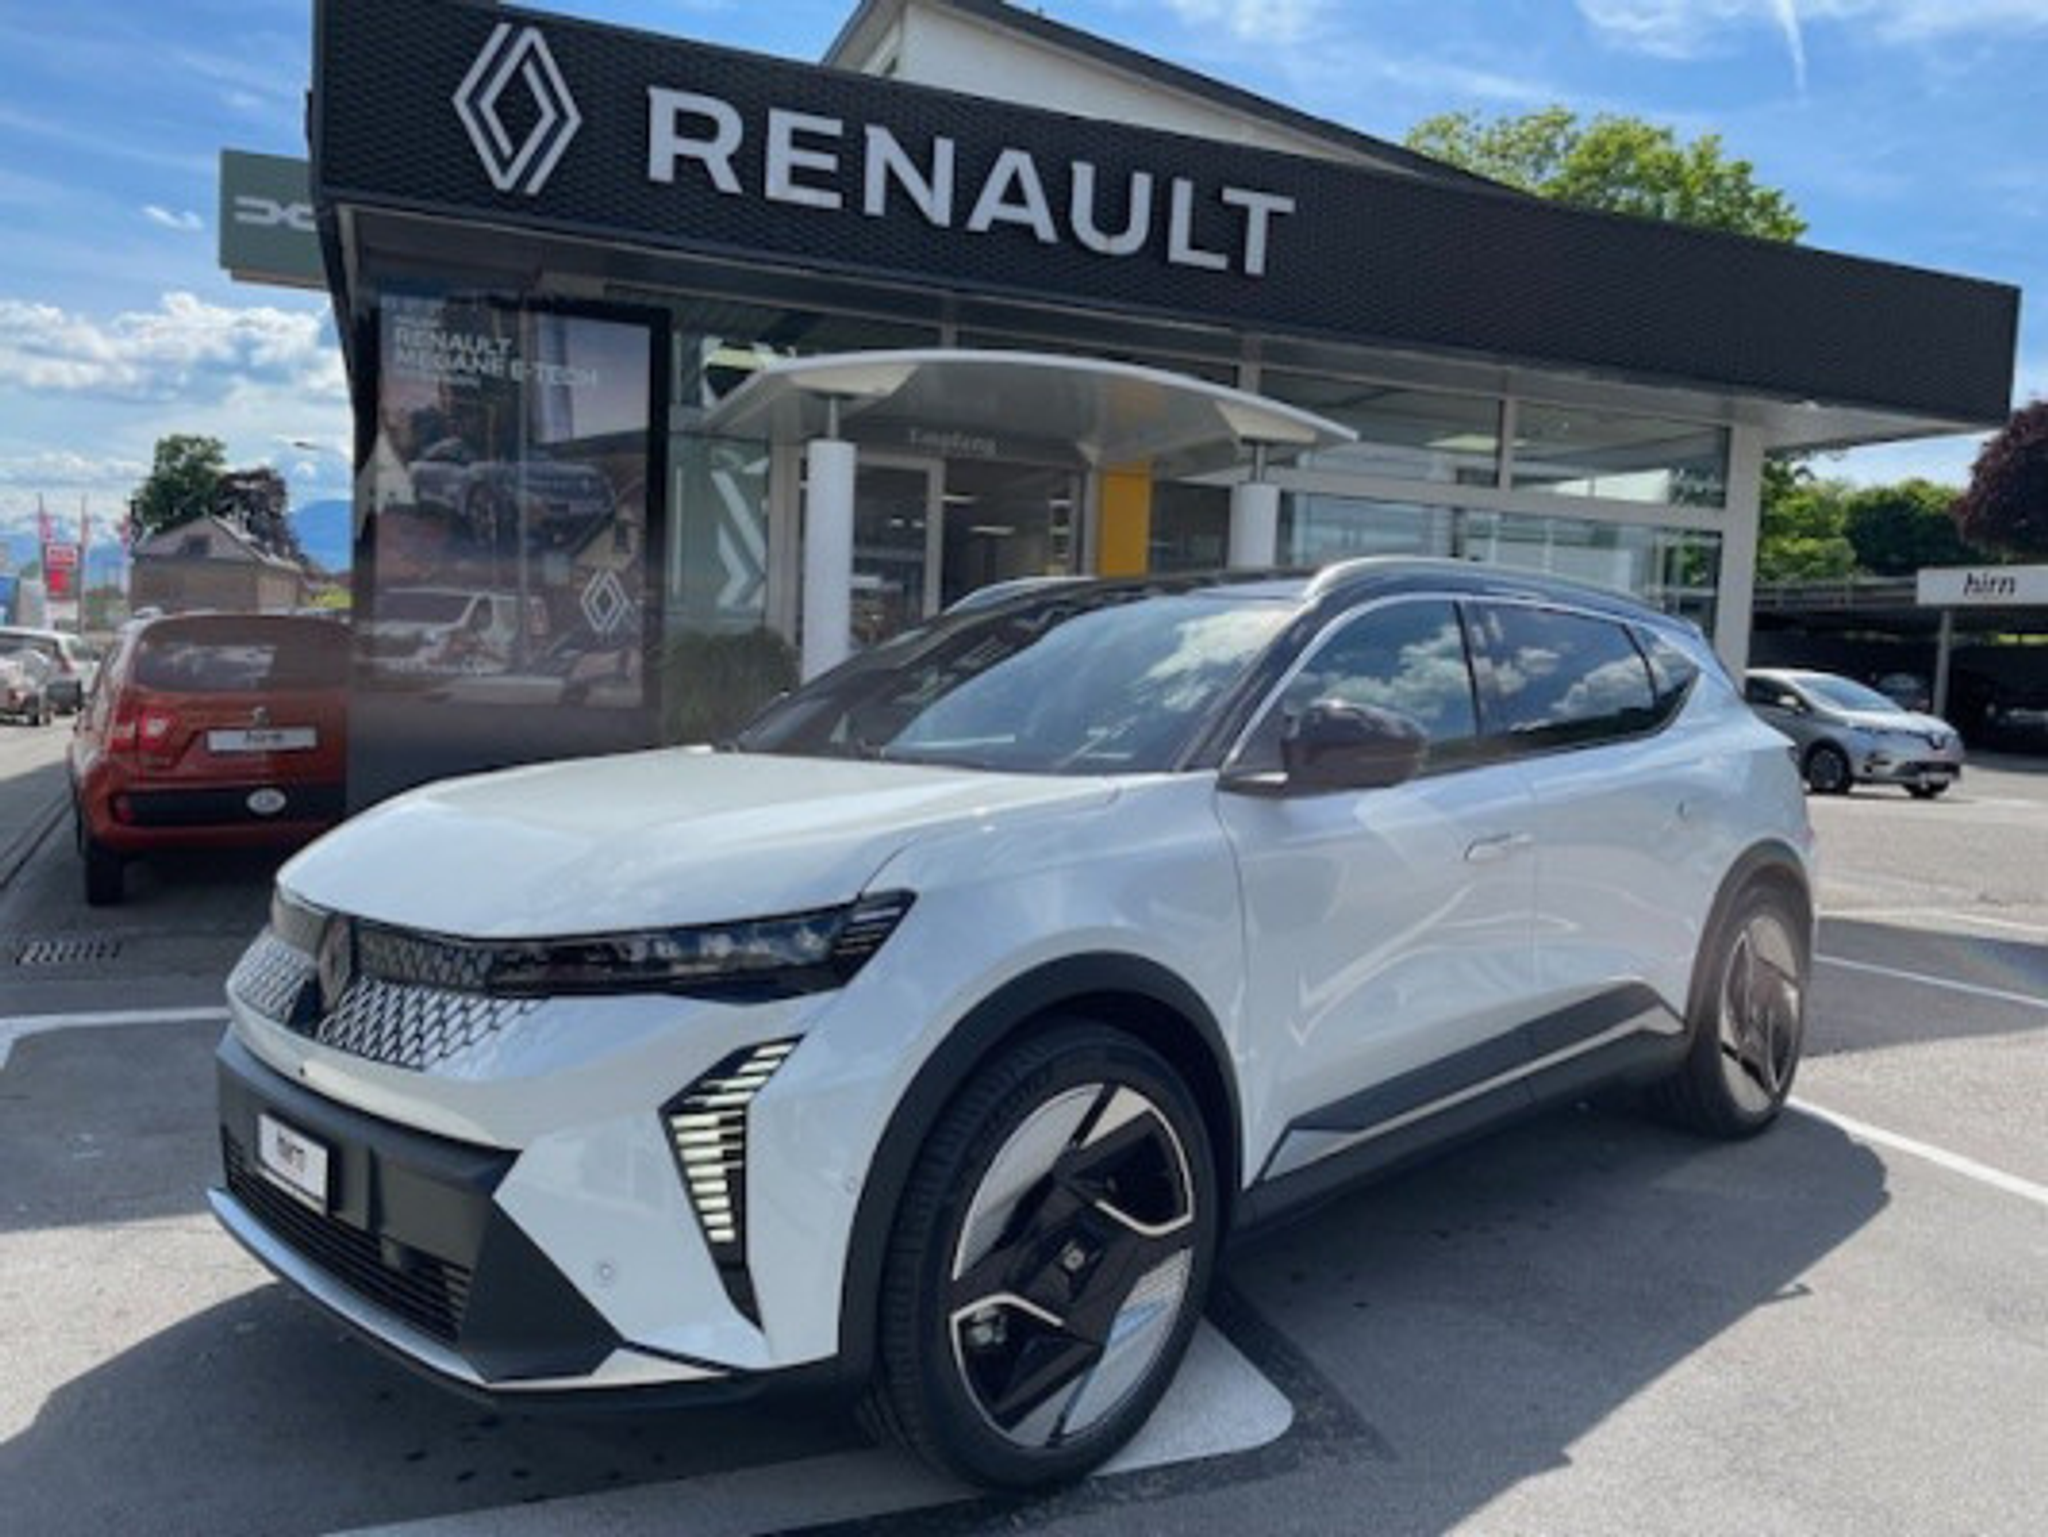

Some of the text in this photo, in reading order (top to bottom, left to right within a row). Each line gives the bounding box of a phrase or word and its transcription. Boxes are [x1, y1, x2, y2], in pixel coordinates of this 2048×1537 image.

[648, 86, 1296, 276] RENAULT
[394, 325, 513, 355] RENAULT
[1963, 572, 2016, 597] hirn
